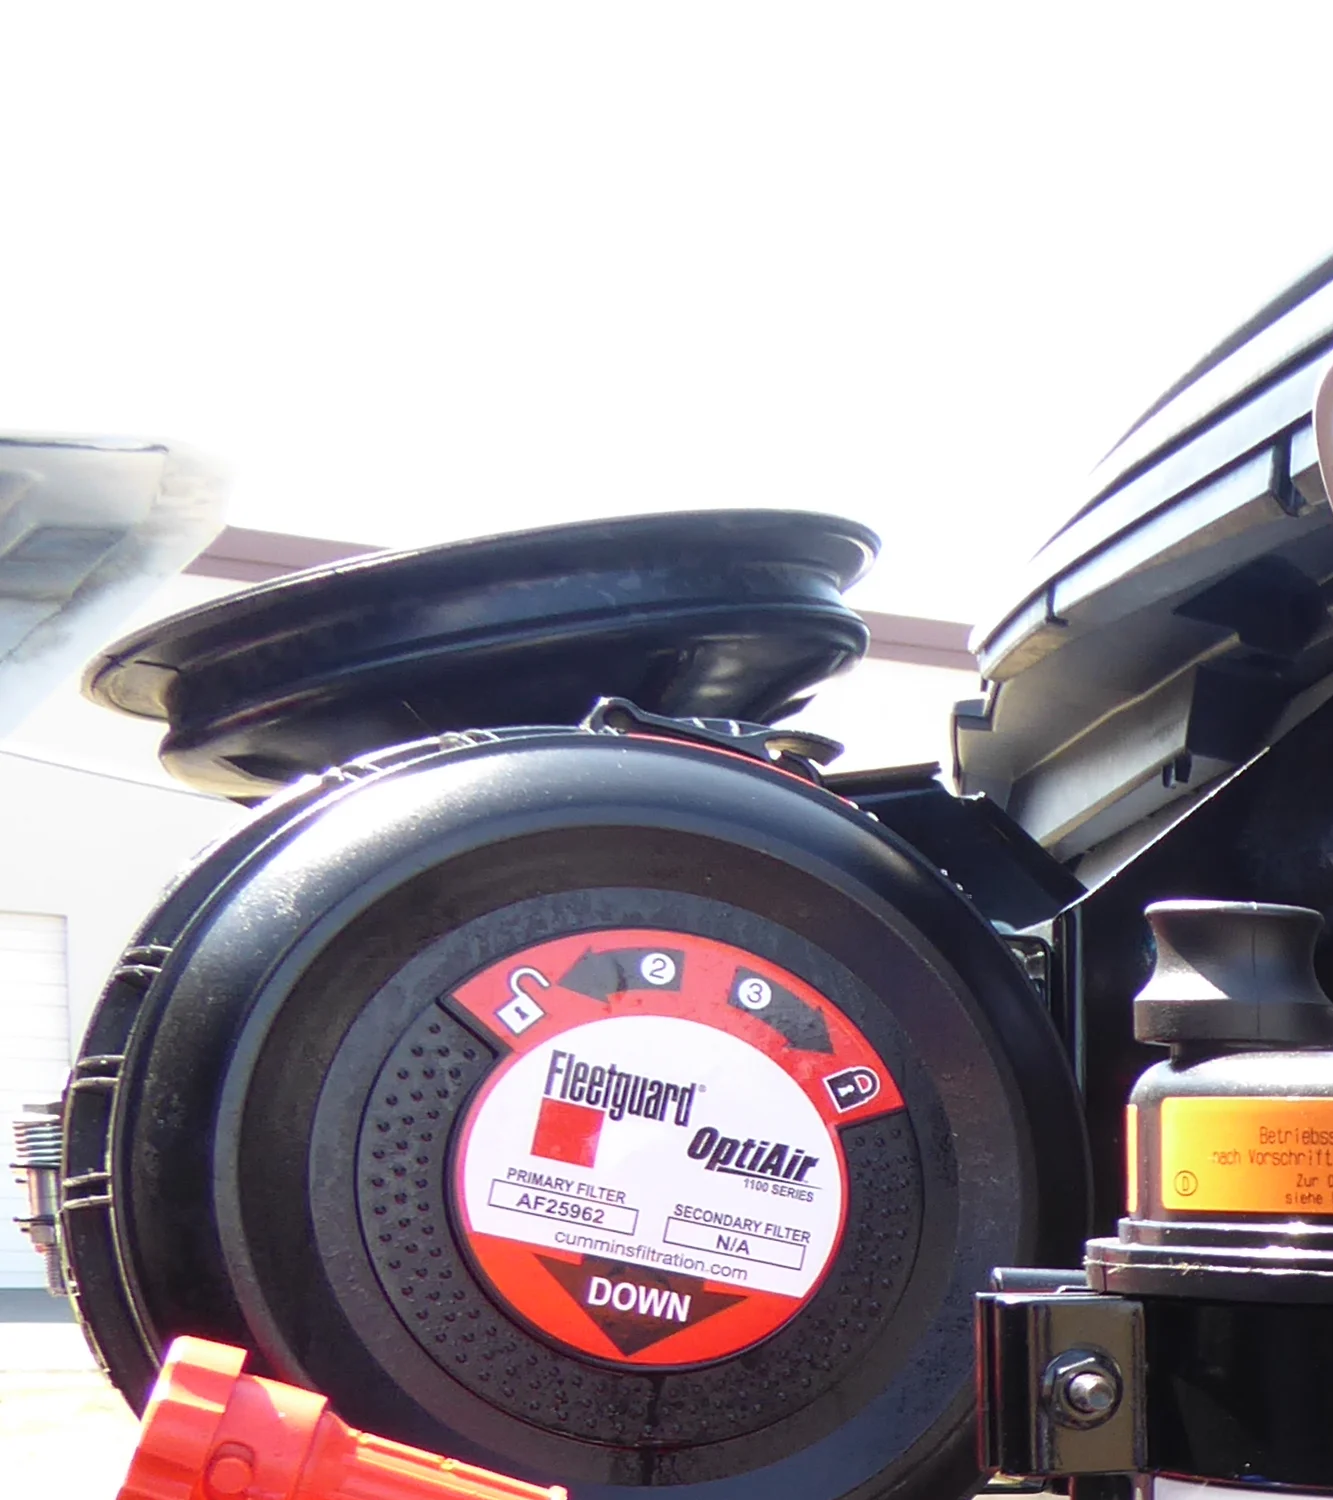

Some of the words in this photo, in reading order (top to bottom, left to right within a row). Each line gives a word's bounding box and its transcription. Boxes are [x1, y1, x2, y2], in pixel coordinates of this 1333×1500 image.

[650, 957, 667, 979] 2
[747, 981, 764, 1004] 3
[543, 1049, 697, 1127] Fleetguard
[687, 1127, 819, 1182] OptiAir
[1249, 1151, 1333, 1168] Vorschrift
[507, 1167, 575, 1193] PRIMARY
[576, 1182, 626, 1203] FILTER
[744, 1179, 769, 1192] 1100
[771, 1184, 814, 1202] SERIES
[1296, 1174, 1318, 1188] Zur
[516, 1193, 605, 1224] AF25962
[1285, 1192, 1323, 1205] siehe
[674, 1204, 762, 1232] SECONDARY
[765, 1223, 811, 1243] FILTER
[555, 1231, 747, 1280] cumminsfiltration.com
[716, 1235, 750, 1255] N/A
[587, 1276, 690, 1322] DOWN
